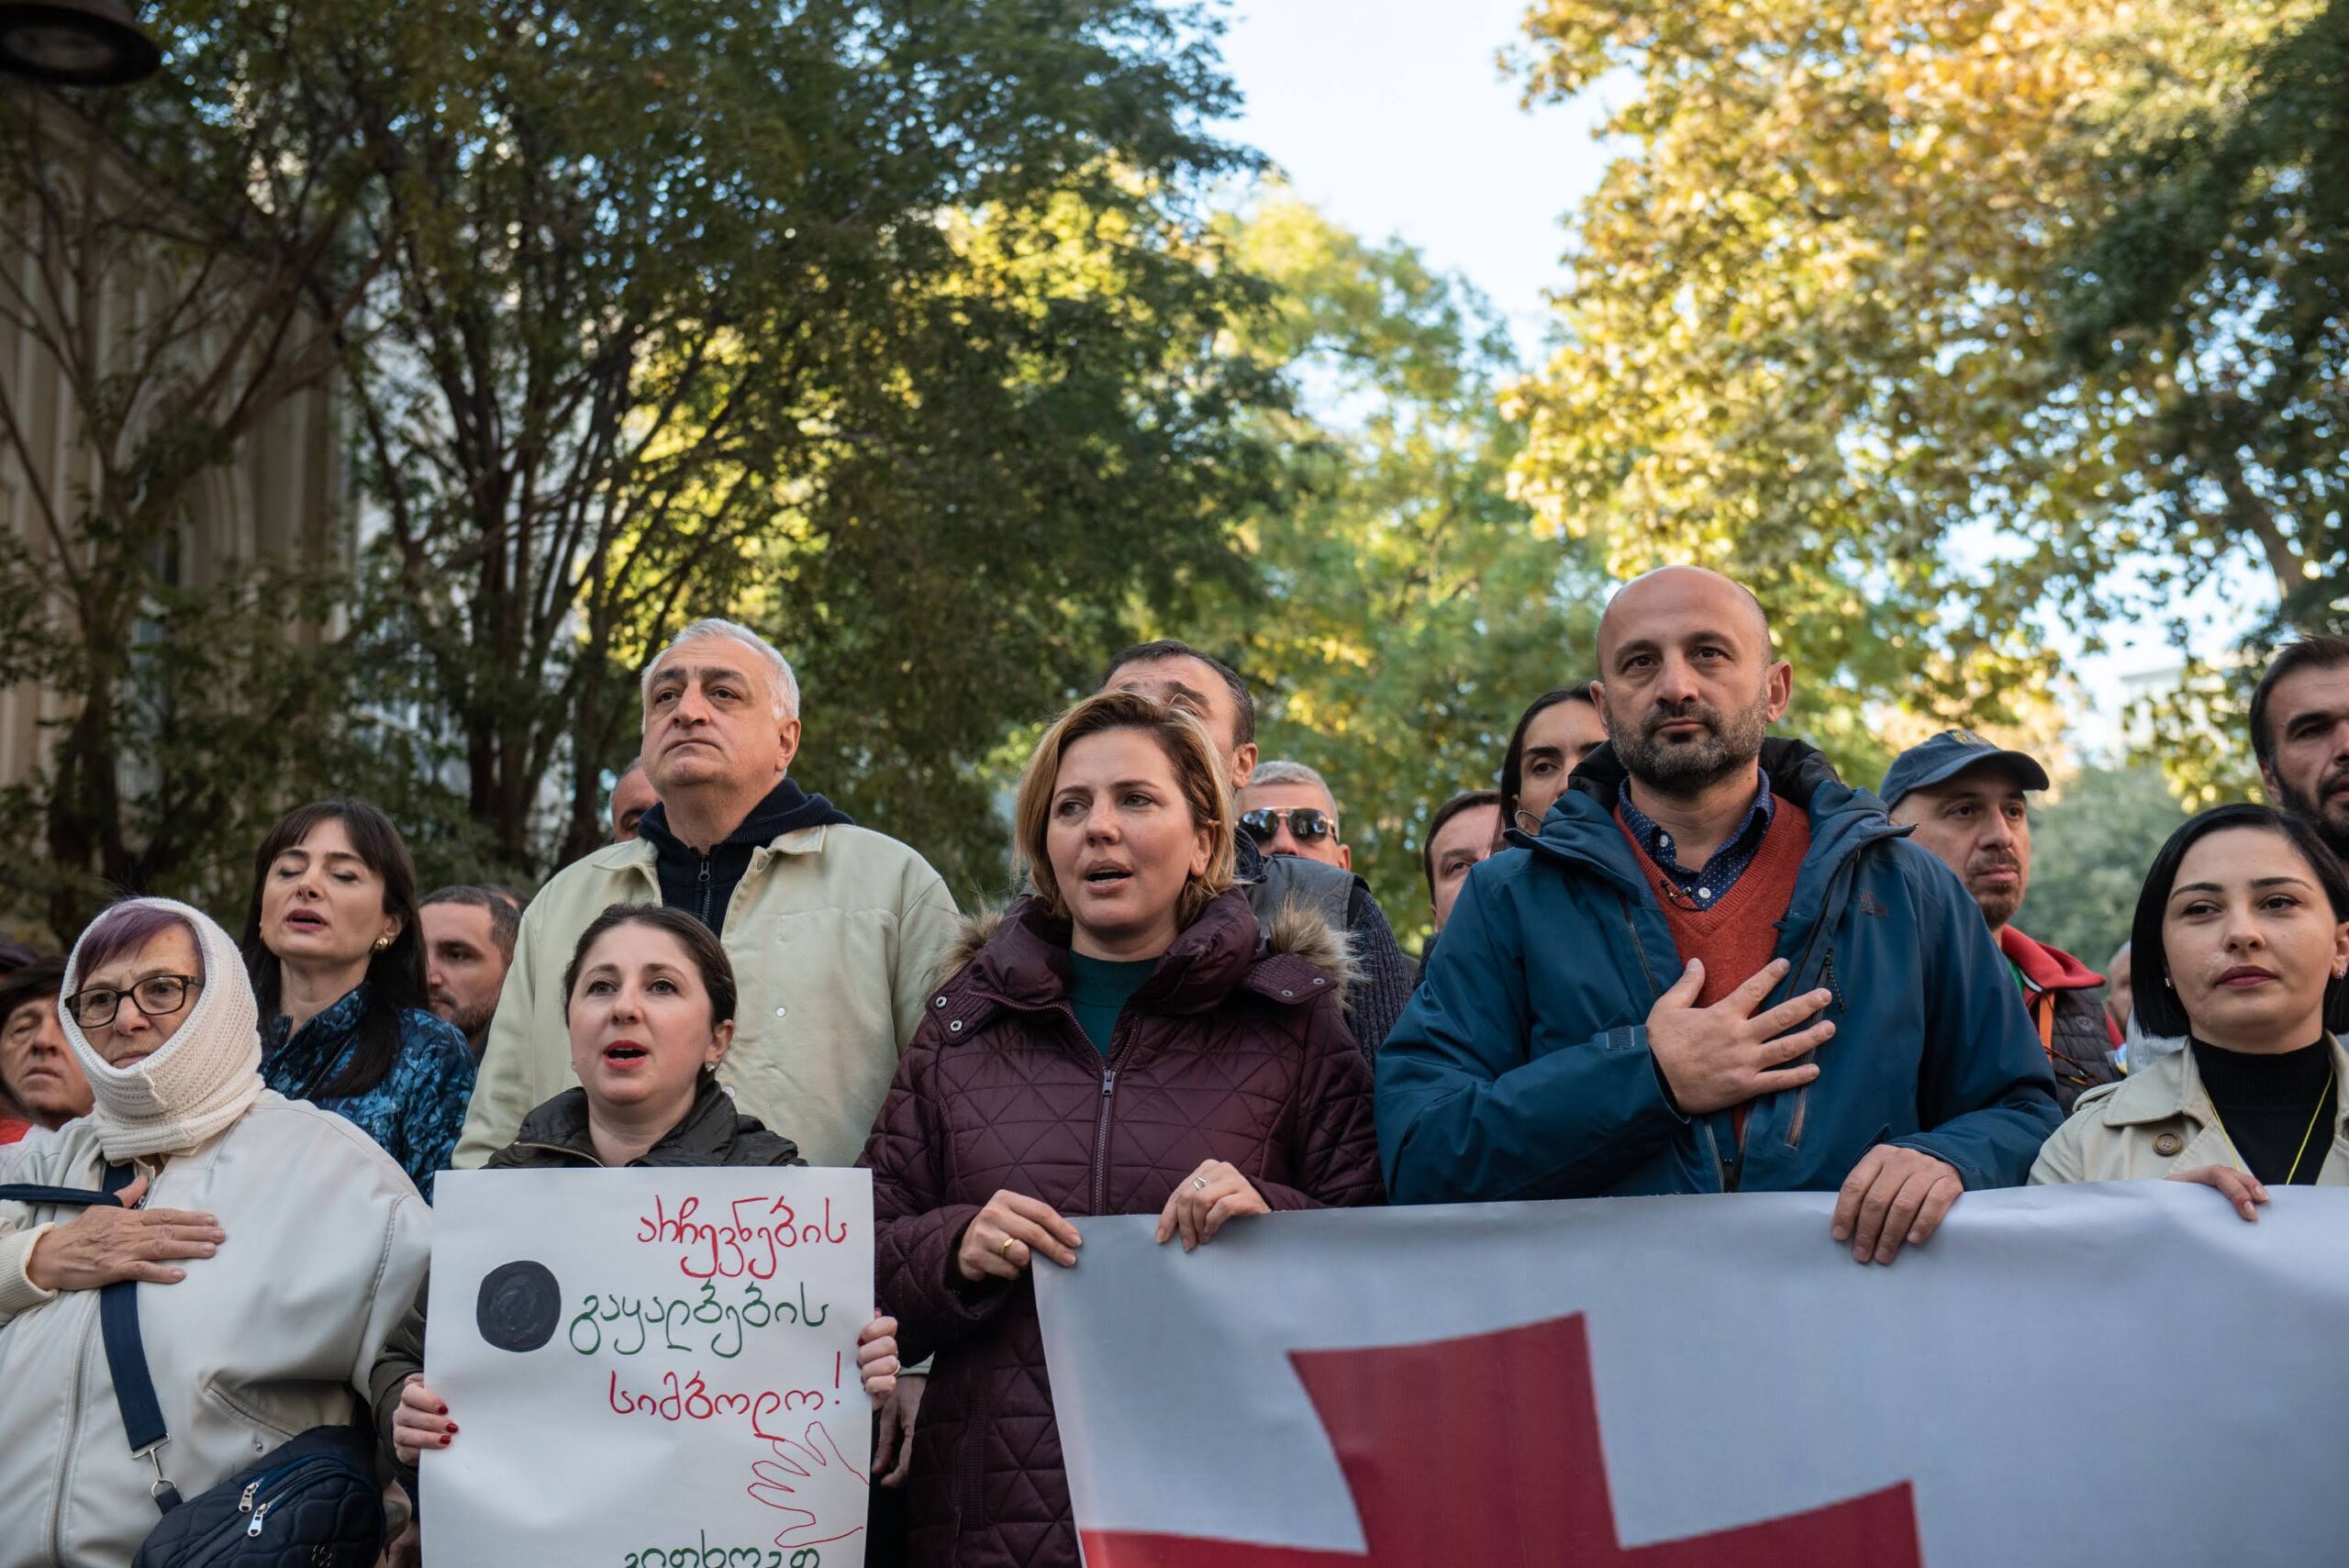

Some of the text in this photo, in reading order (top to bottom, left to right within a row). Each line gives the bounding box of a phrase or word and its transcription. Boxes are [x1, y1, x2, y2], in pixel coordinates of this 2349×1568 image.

[638, 1195, 847, 1280] არჩევნების
[569, 1278, 829, 1358] გაყალბების
[609, 1351, 841, 1442] სიმბოლო!
